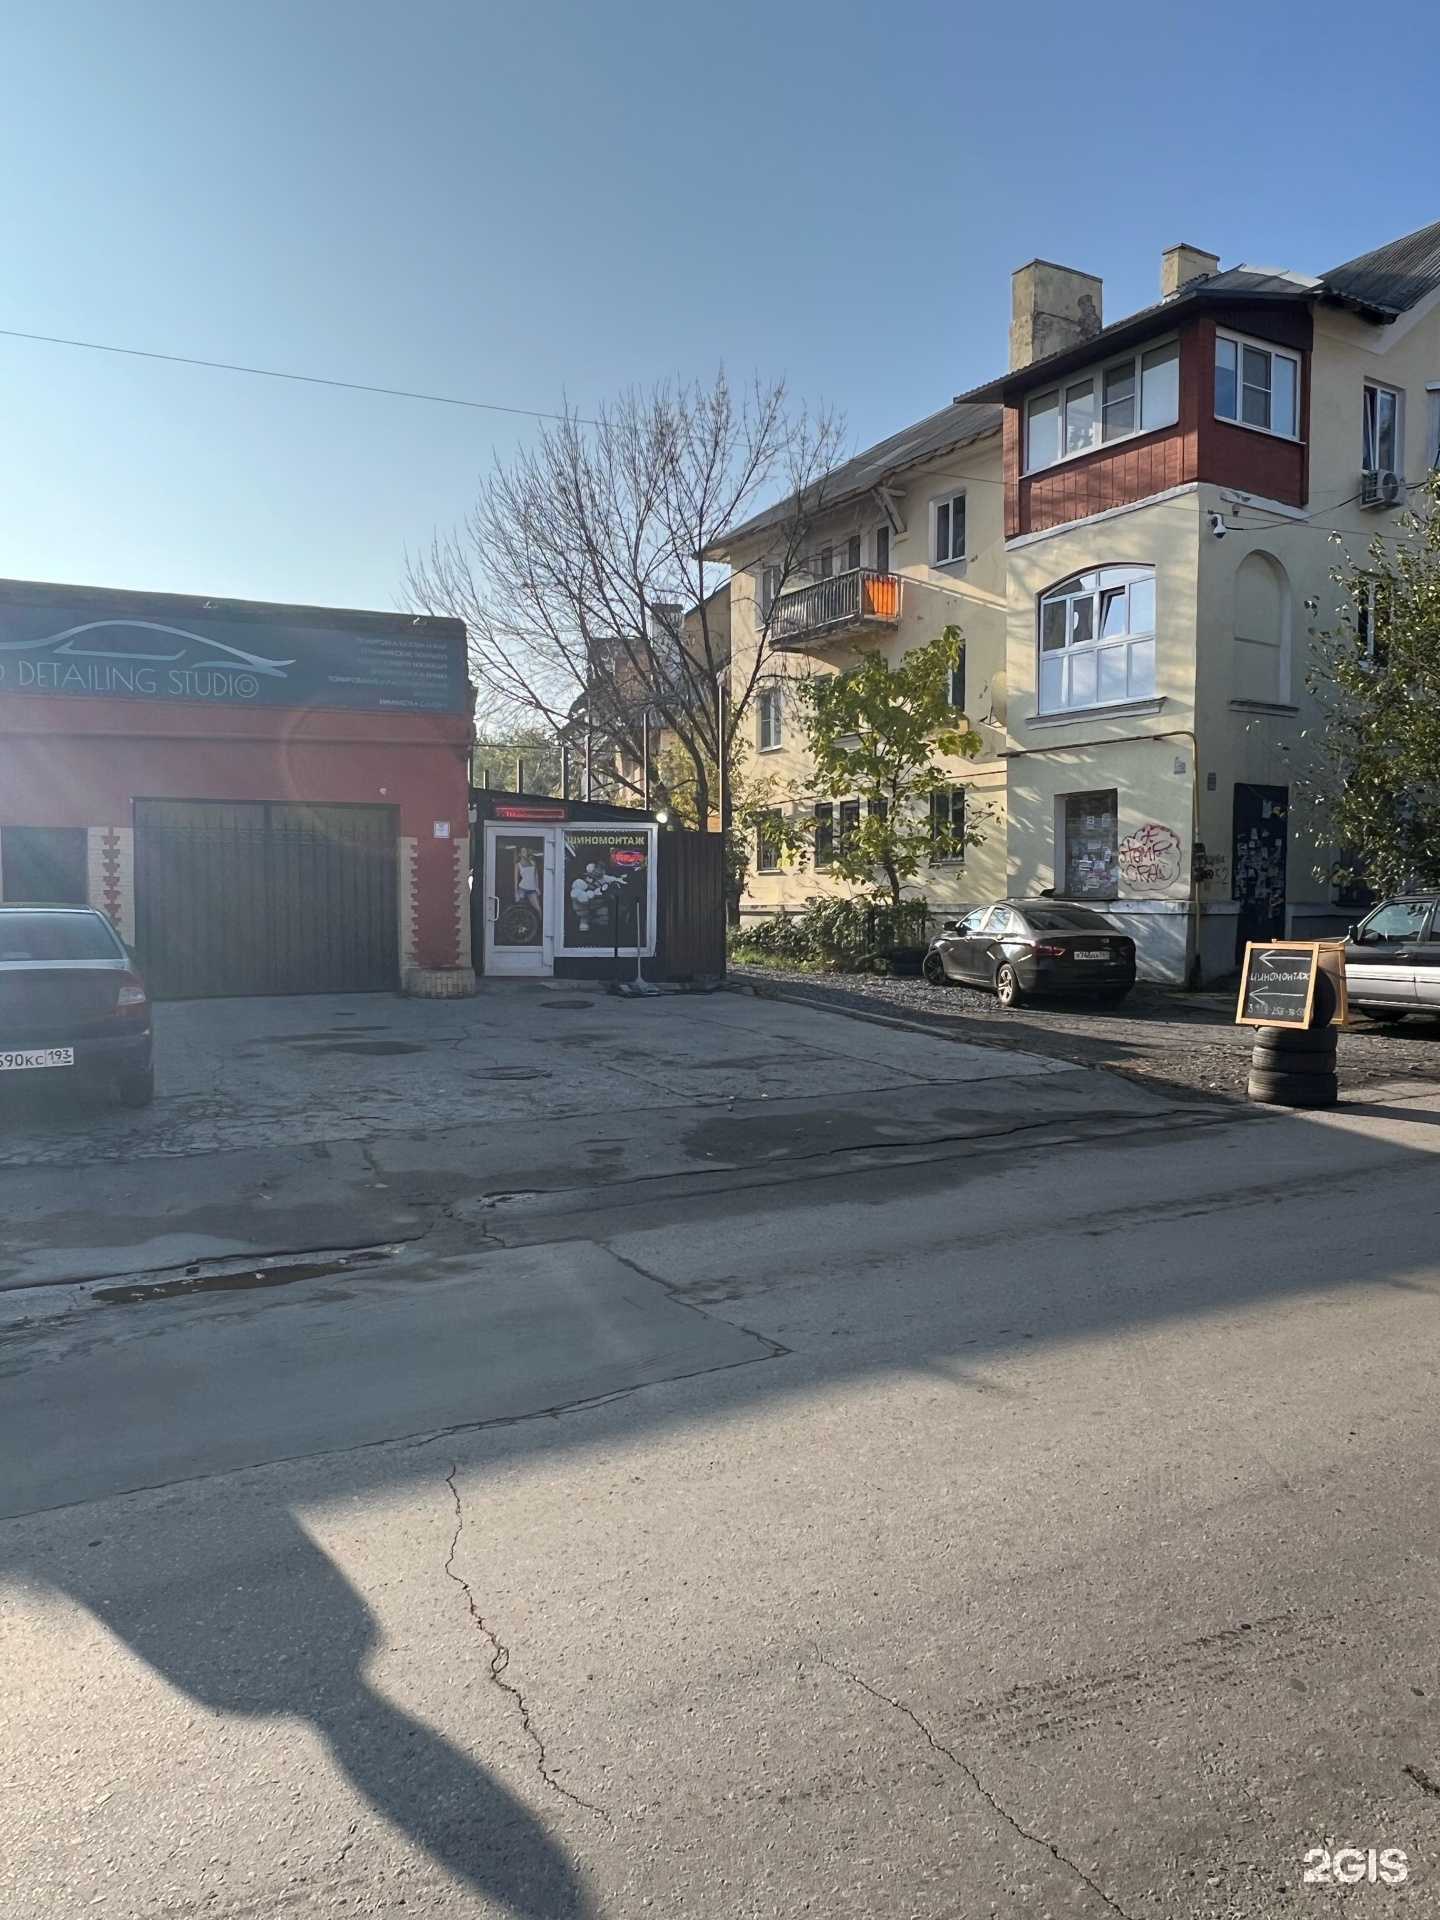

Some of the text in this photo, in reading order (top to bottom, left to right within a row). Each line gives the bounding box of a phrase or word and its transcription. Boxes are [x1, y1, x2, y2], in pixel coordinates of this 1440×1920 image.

[18, 660, 157, 693] DETAILING
[567, 835, 645, 846] ШИНОМОНТАЖ
[48, 1049, 73, 1060] 193
